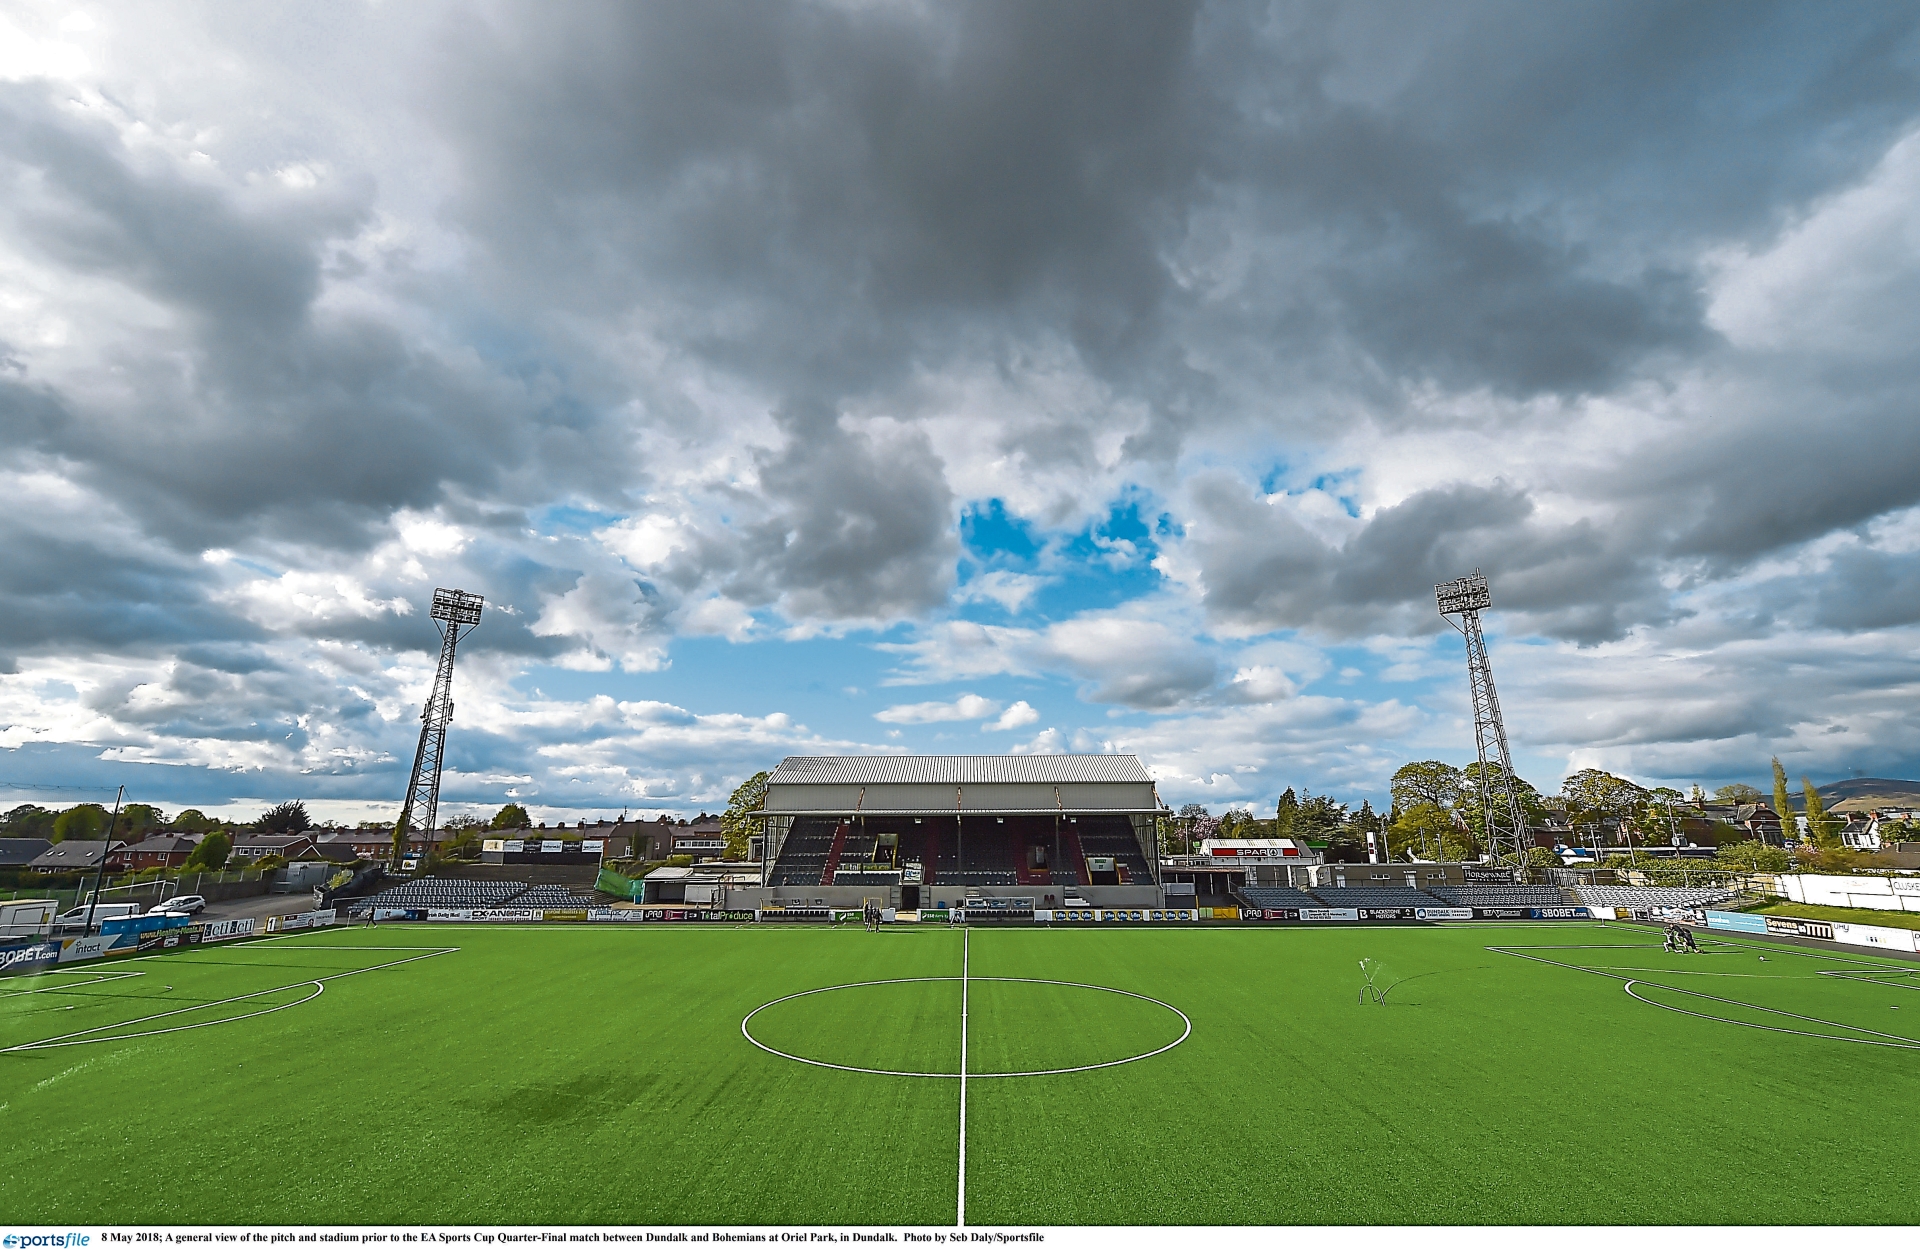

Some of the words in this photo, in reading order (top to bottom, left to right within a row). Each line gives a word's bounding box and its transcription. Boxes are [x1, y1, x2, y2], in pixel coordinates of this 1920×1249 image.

[700, 910, 753, 920] TotalProduce
[1542, 908, 1587, 917] SBOBET.com
[1766, 918, 1798, 929] Sevens
[75, 941, 101, 954] intact
